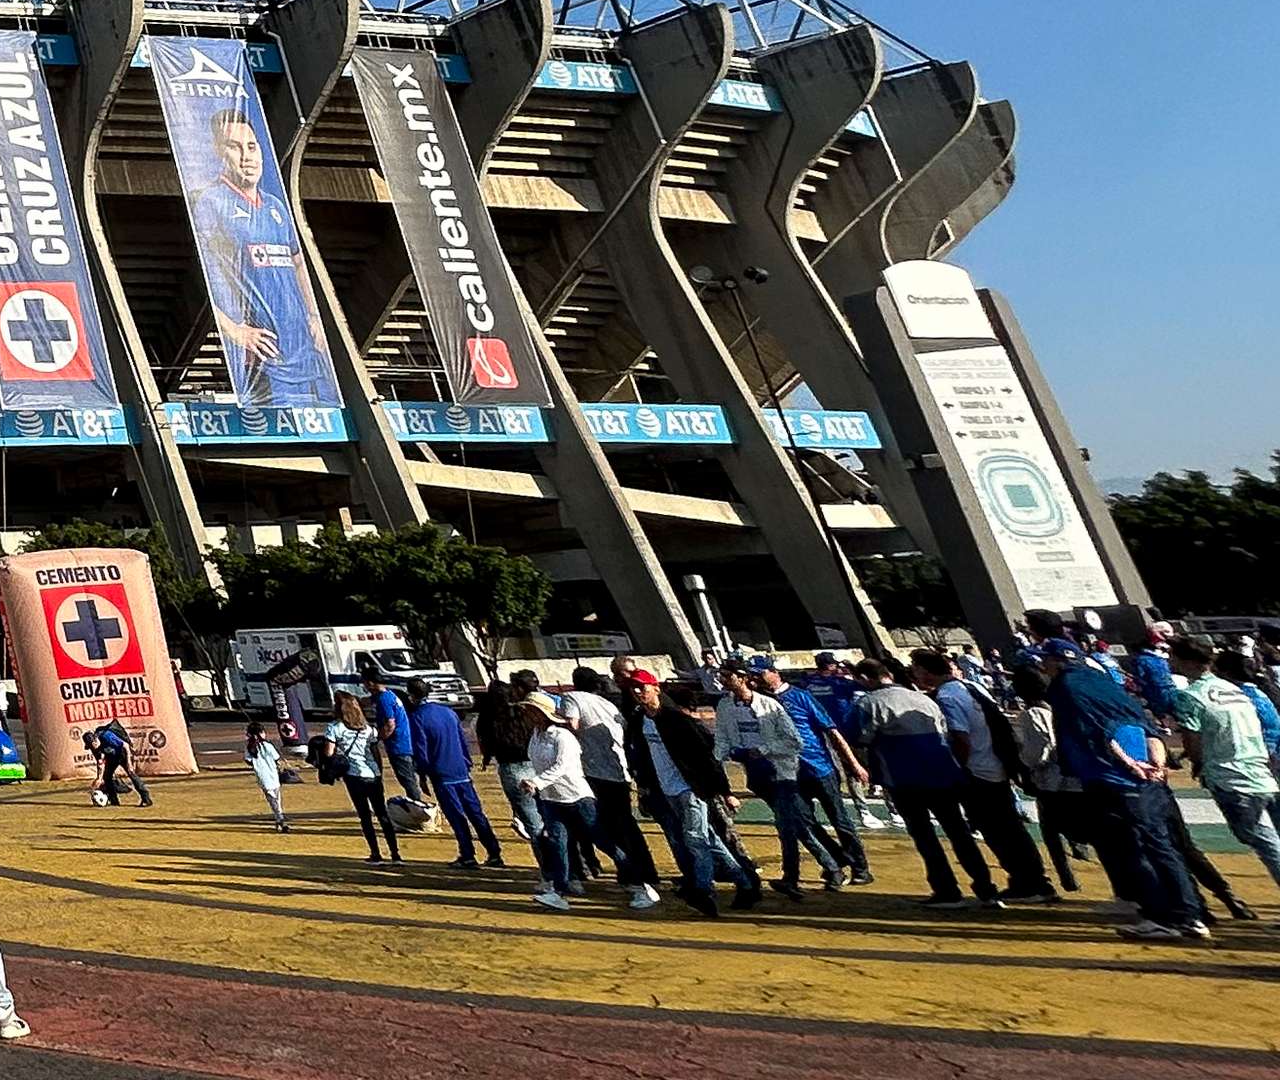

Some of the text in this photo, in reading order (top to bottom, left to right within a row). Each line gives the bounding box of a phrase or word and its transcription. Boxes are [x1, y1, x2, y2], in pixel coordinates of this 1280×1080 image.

[576, 61, 623, 89] AT&T
[170, 82, 251, 99] PIRMA
[13, 156, 71, 265] CRUZ
[385, 63, 495, 332] caliente.mx
[52, 409, 117, 437] AT&T
[170, 408, 335, 437] AT&T AT&T
[479, 408, 532, 434] AT&T
[666, 410, 716, 436] AT&T
[824, 417, 868, 440] AT&T
[35, 565, 121, 585] CEMENTO
[60, 676, 149, 700] CRUZ AZUL
[67, 699, 150, 721] MORTERO
